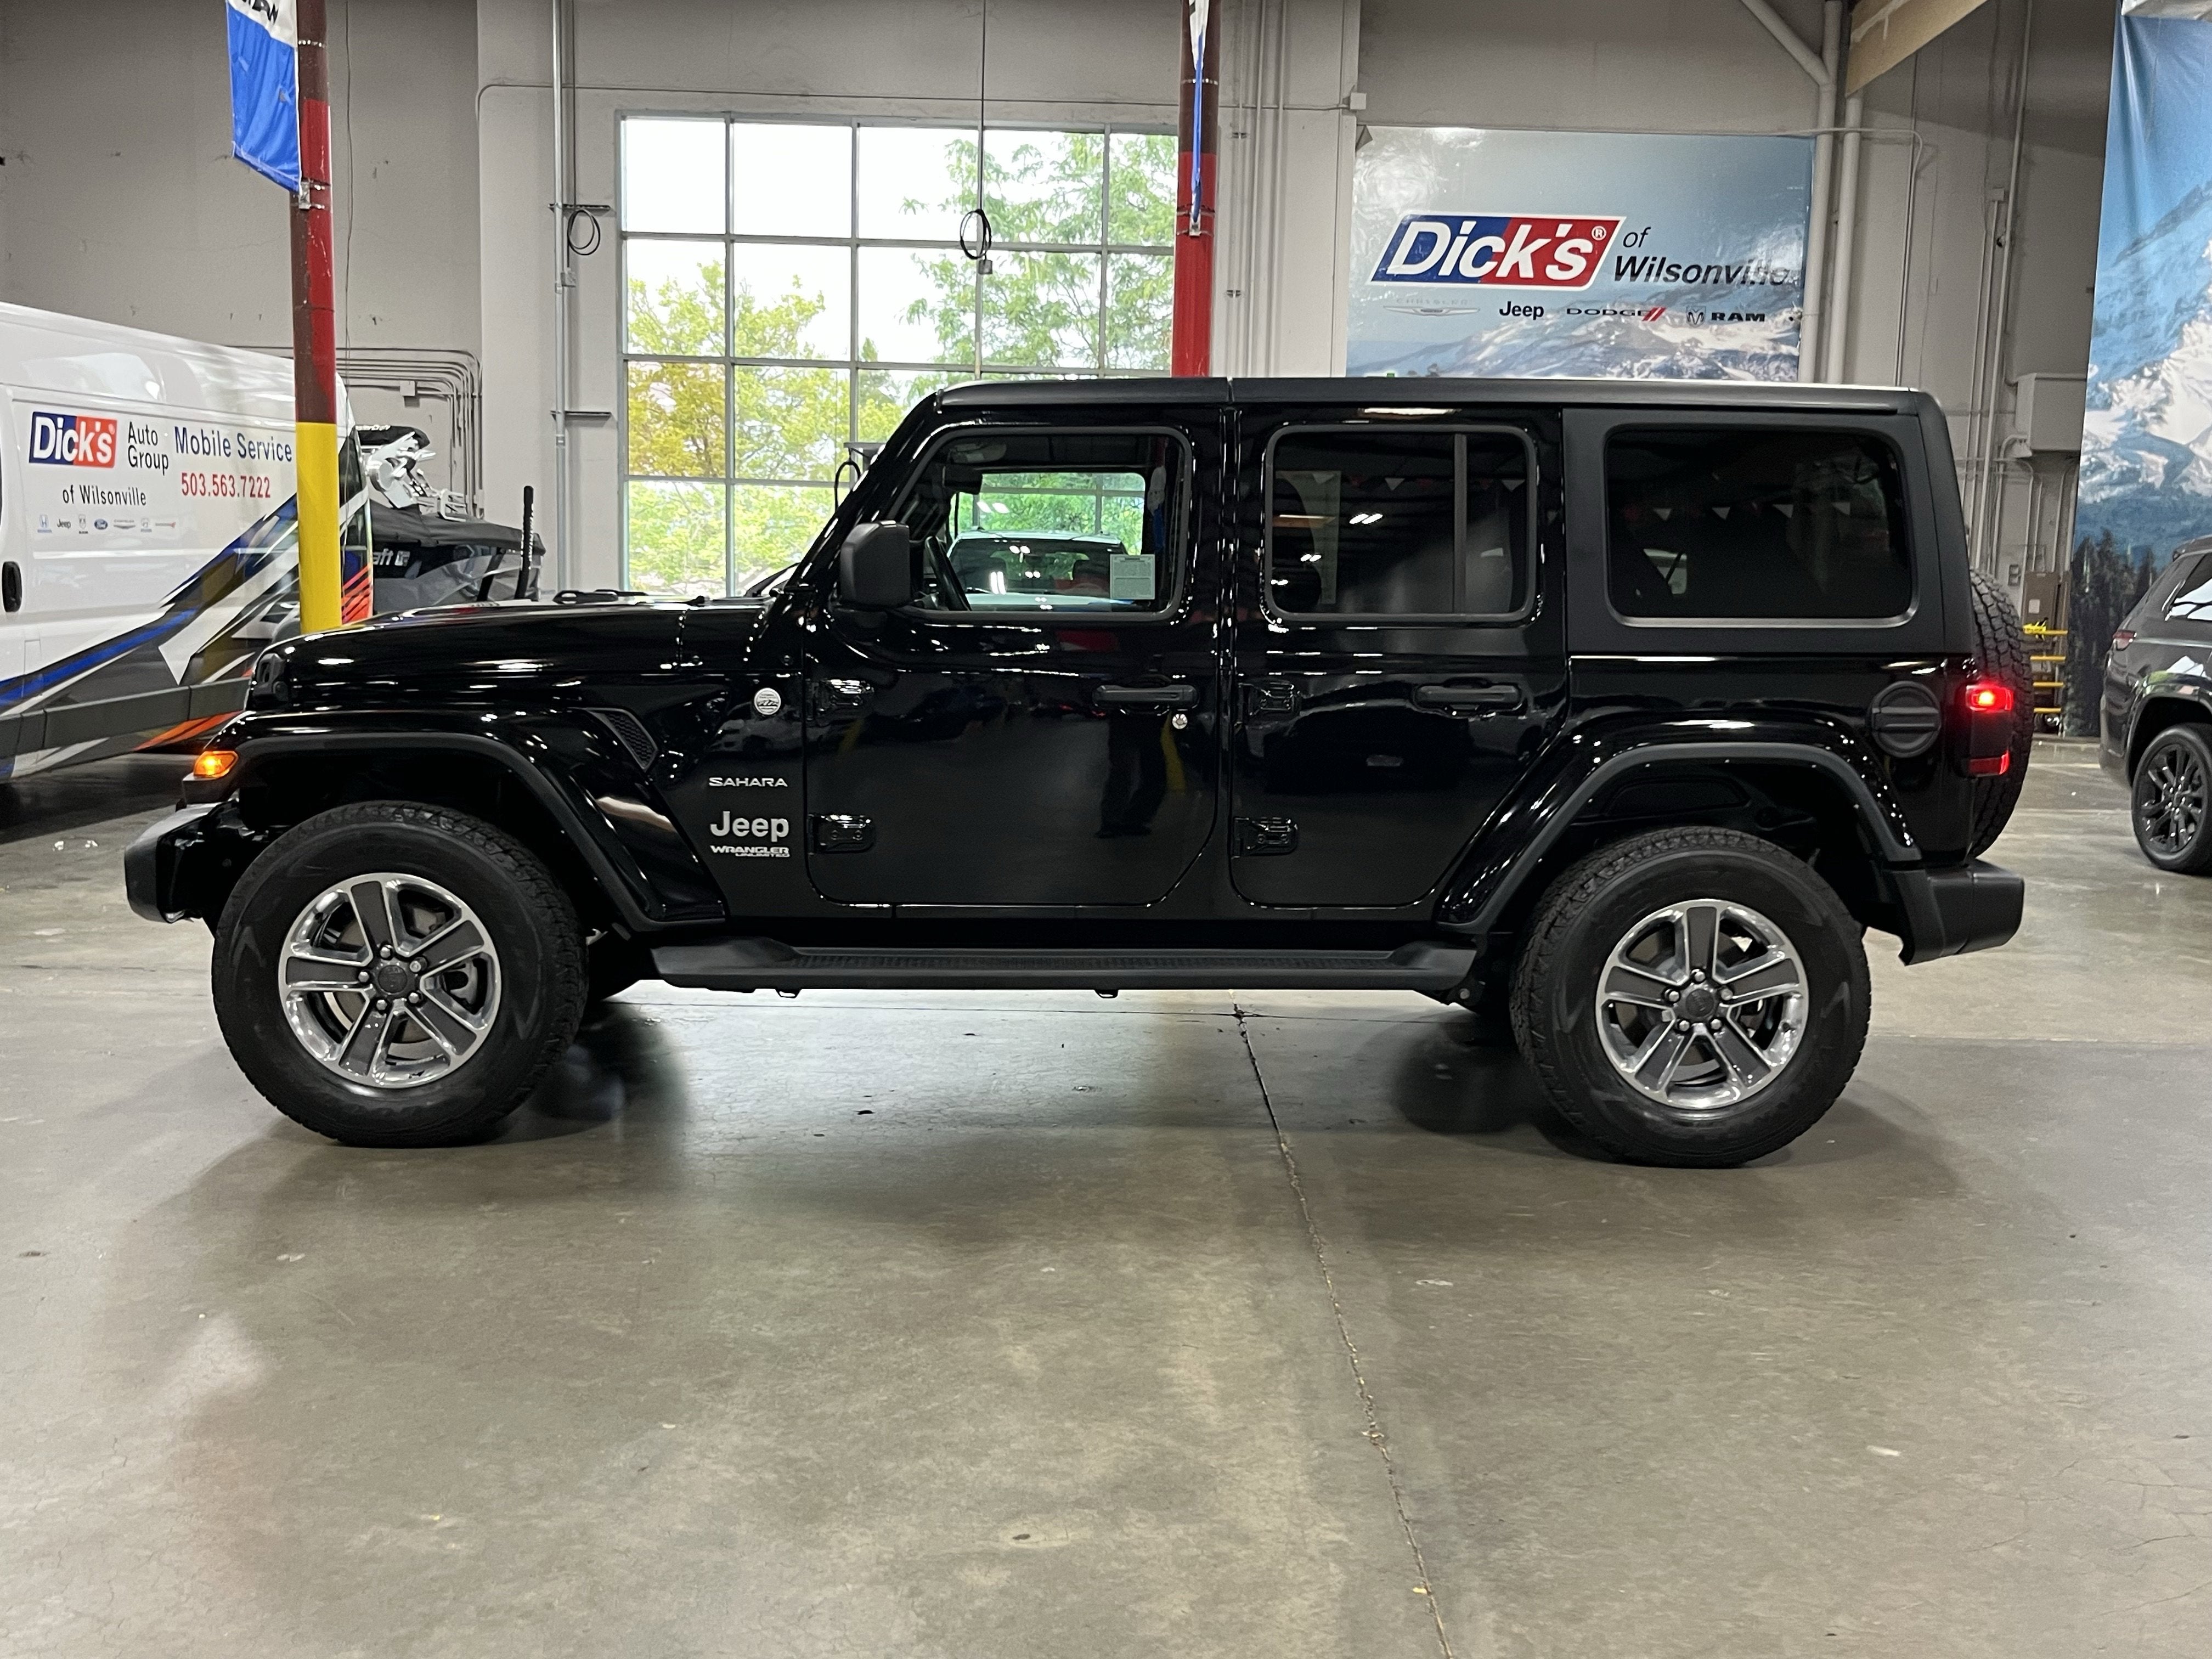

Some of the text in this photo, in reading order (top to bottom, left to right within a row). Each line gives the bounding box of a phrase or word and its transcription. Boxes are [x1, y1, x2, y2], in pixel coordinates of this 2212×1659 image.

[1622, 227, 1651, 248] of
[1499, 301, 1544, 320] Jeep
[1711, 312, 1766, 323] RAM
[127, 421, 159, 446] Auto
[174, 426, 292, 462] Mobile Service
[127, 445, 169, 476] Group
[62, 484, 146, 506] of Wilsonville
[181, 472, 271, 499] 503.563.7222
[709, 777, 788, 787] SAHARA
[710, 810, 789, 843] Jeep
[709, 845, 789, 854] WRANGLER
